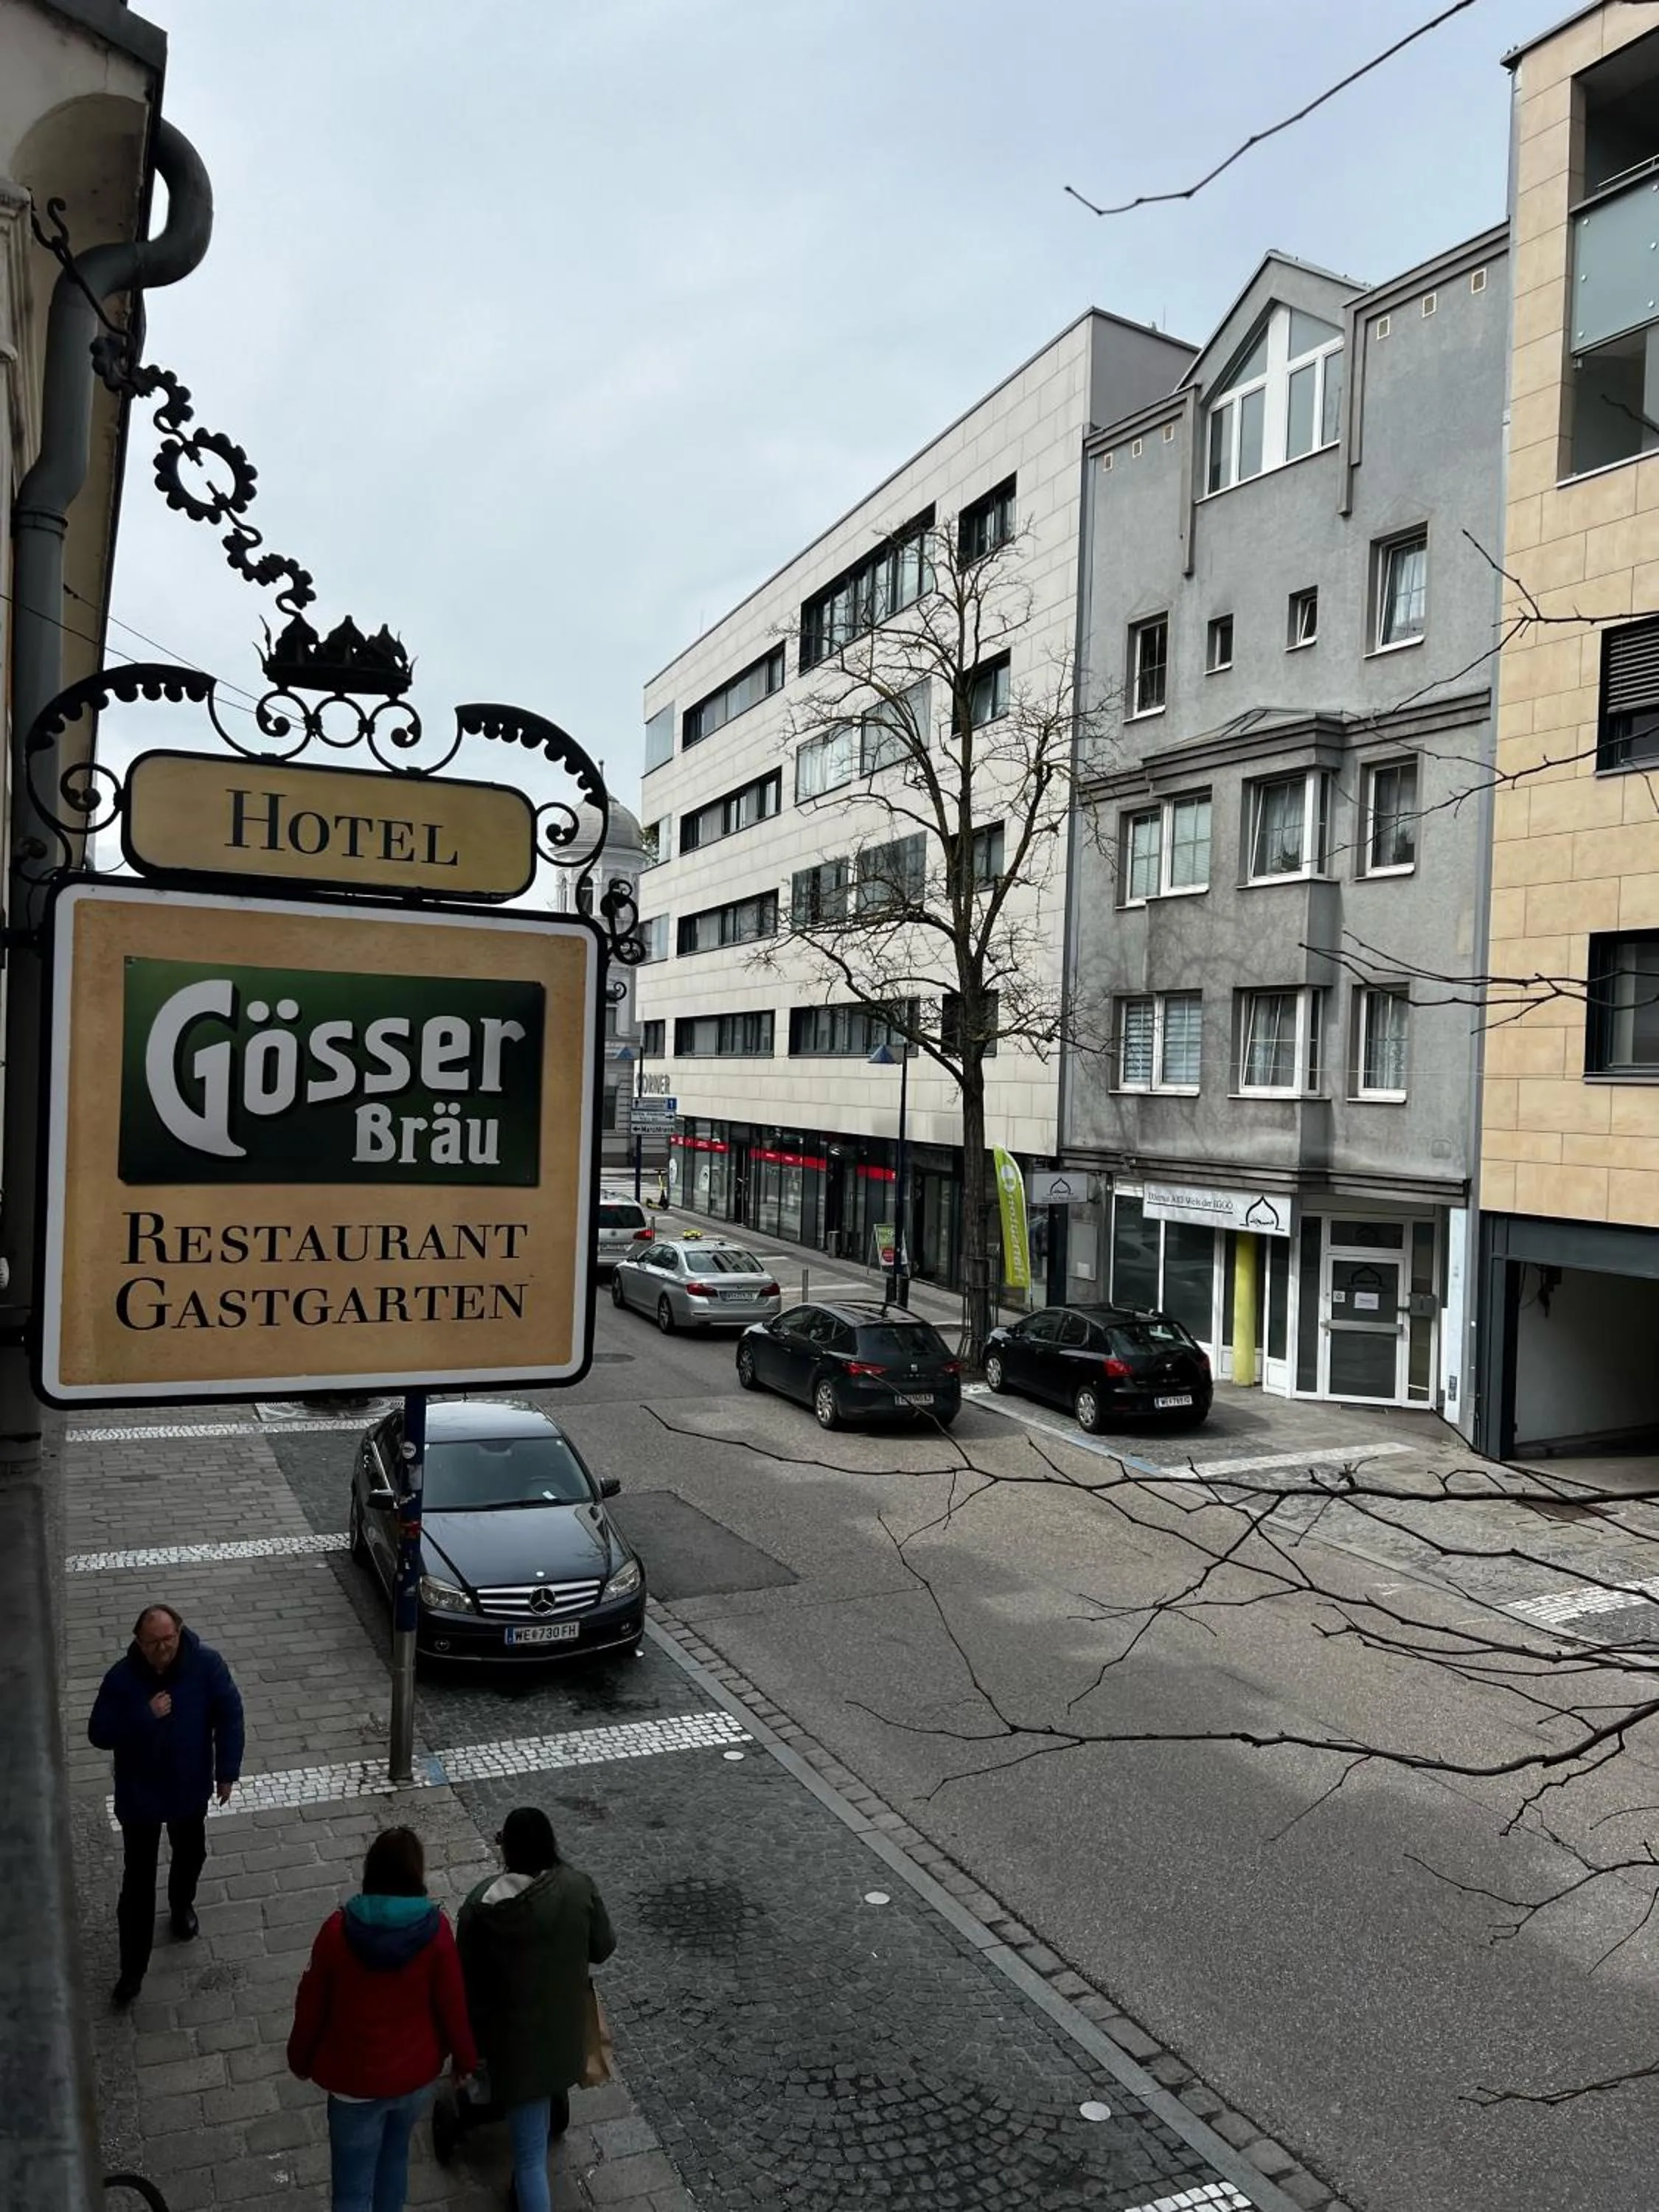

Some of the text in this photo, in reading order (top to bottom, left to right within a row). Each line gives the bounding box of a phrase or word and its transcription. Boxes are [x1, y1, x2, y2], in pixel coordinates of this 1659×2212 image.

[224, 788, 459, 866] HOTEL
[146, 978, 526, 1158] Gösser
[352, 1102, 501, 1166] Bräu
[120, 1211, 529, 1265] RESTAURANT
[115, 1278, 529, 1332] GASTGARTEN
